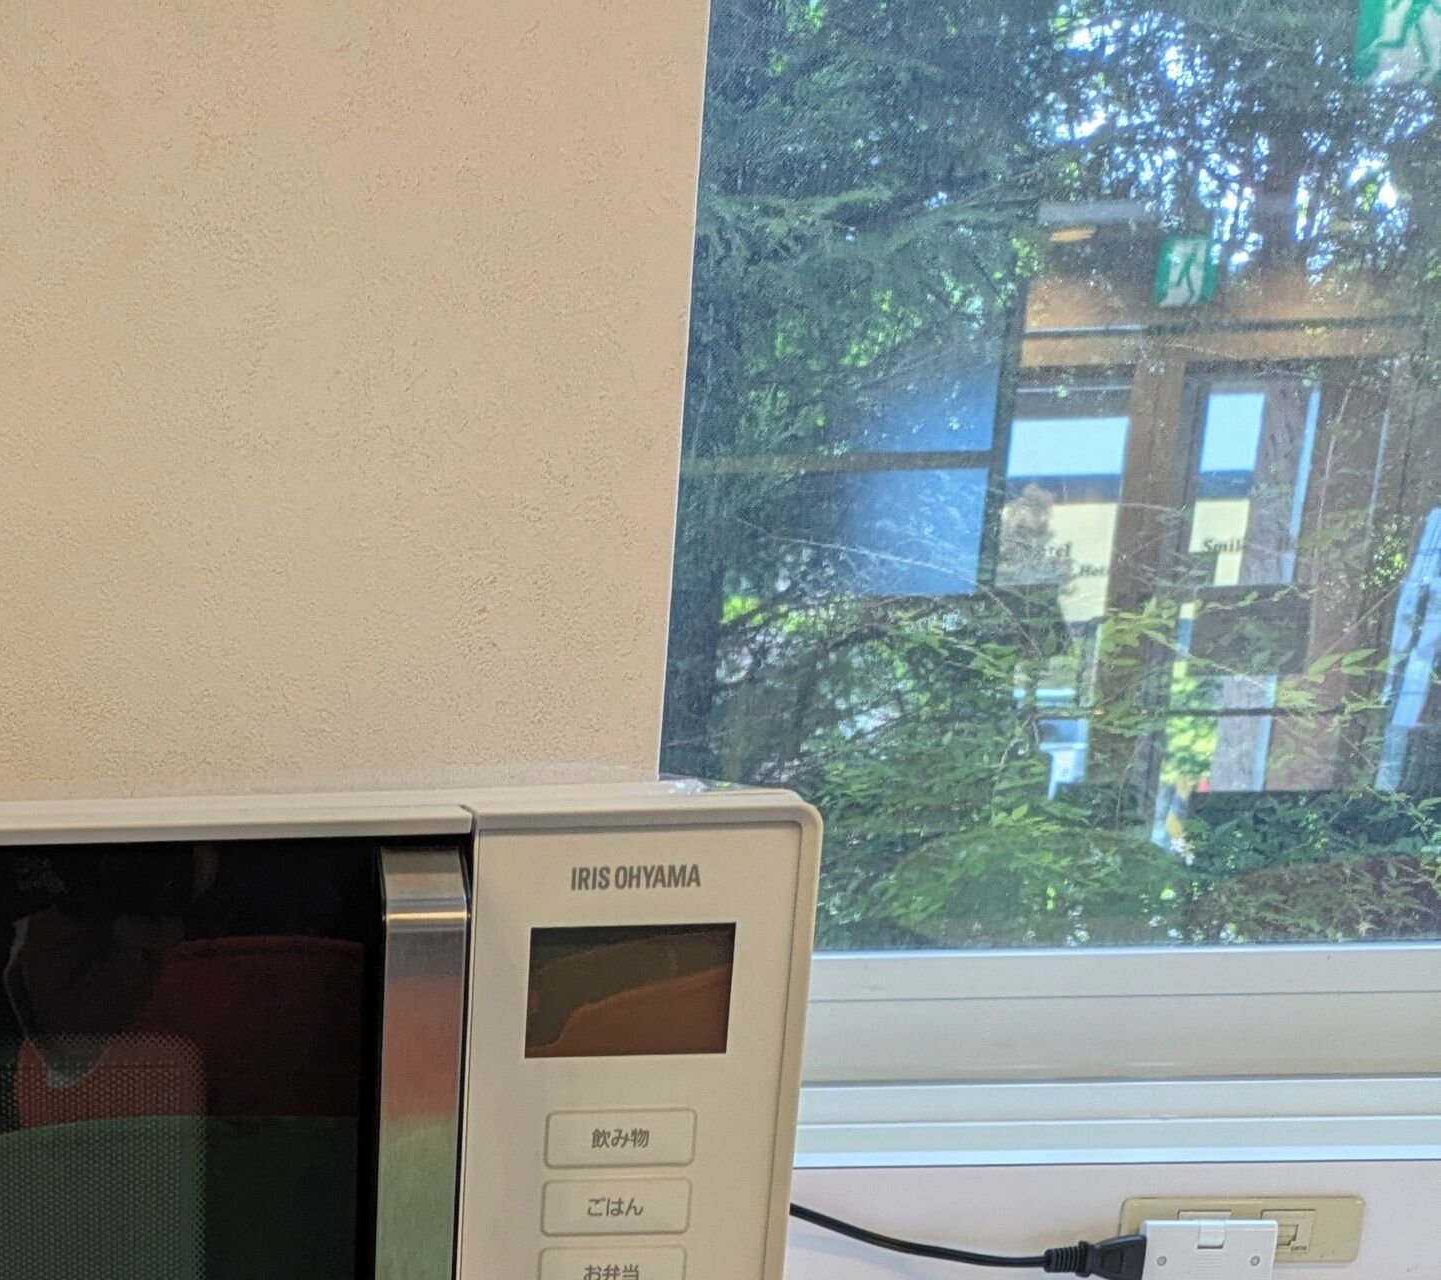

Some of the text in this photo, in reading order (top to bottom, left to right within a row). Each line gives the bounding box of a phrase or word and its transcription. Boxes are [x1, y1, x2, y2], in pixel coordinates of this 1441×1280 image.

[571, 863, 701, 891] IRIS OHYAMA
[590, 1127, 650, 1149] 飲み物
[587, 1196, 644, 1217] ごはん
